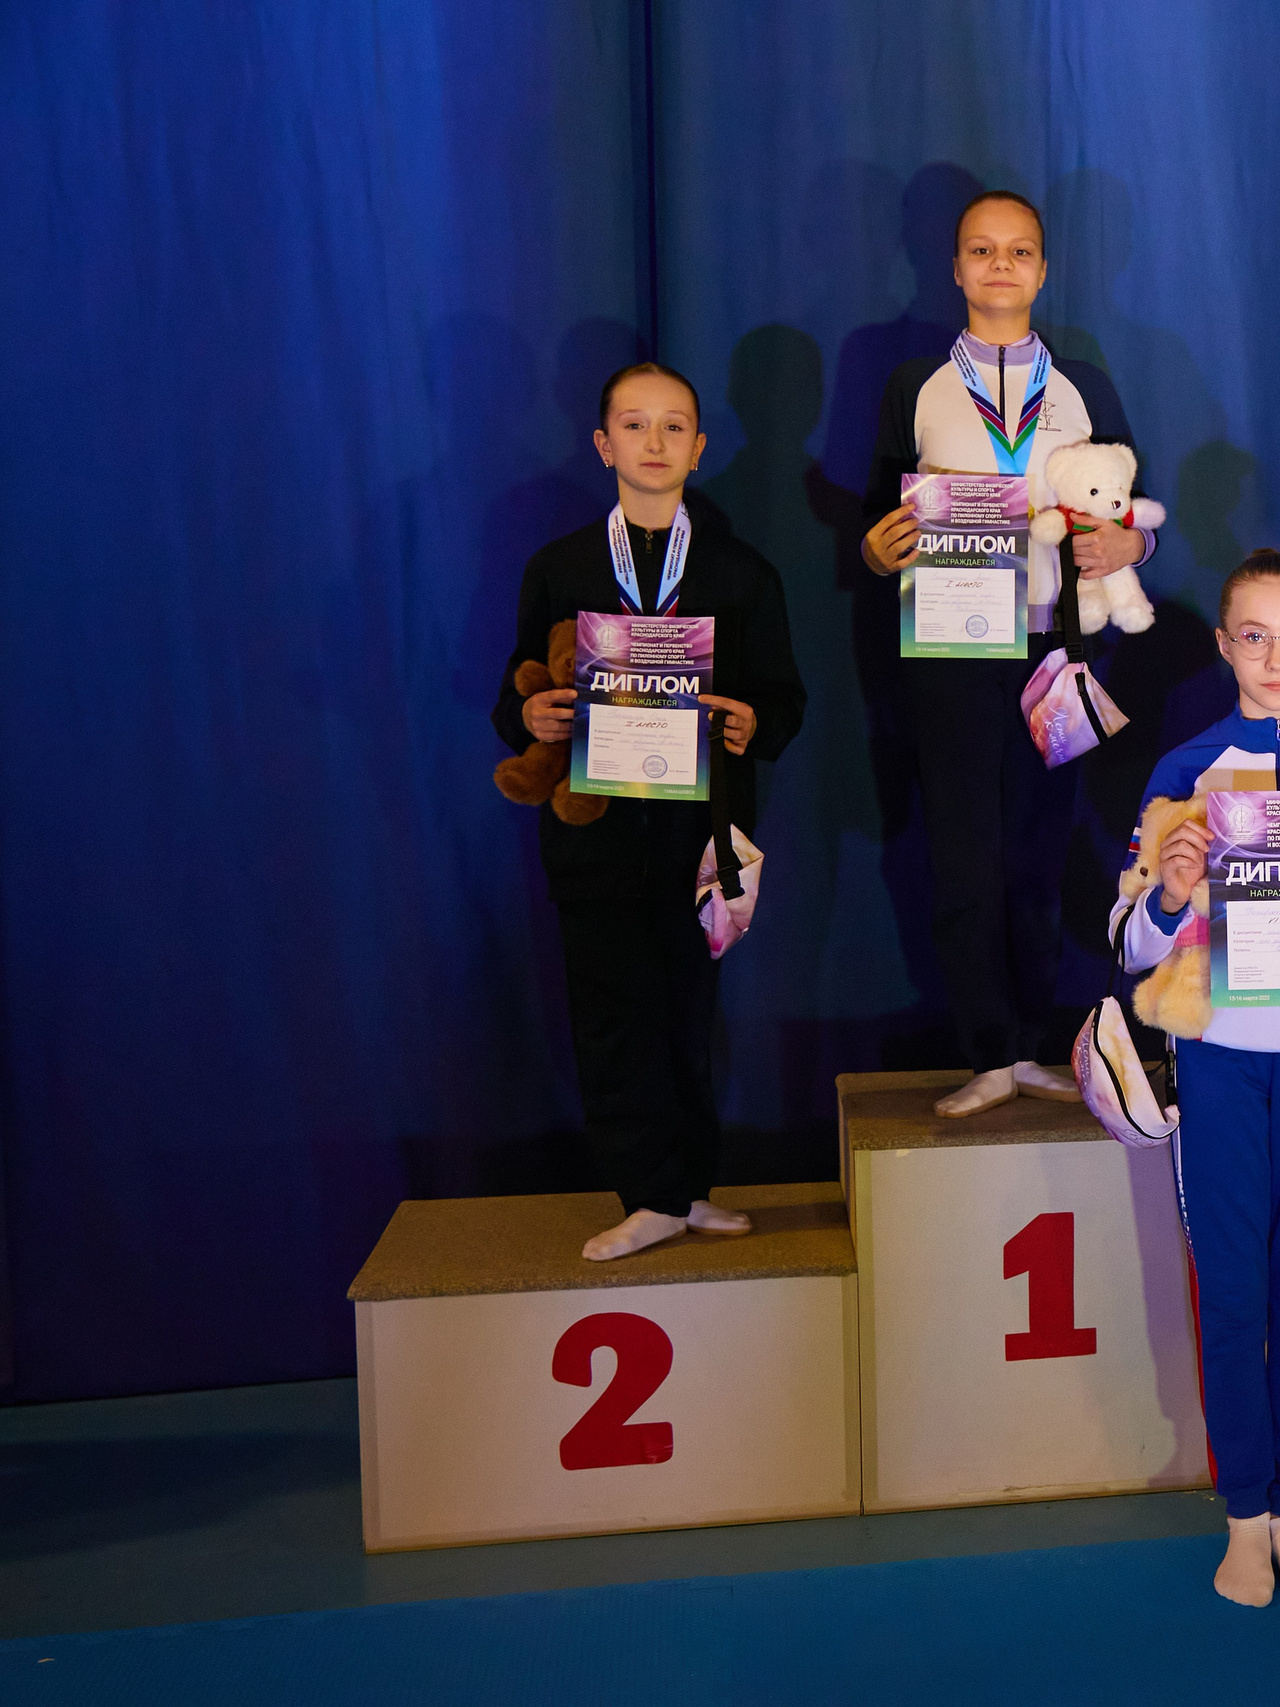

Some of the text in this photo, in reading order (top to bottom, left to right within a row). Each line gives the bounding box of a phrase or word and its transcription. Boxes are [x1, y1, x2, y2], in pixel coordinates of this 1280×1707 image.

[917, 534, 1016, 554] ДИПЛОМ
[936, 558, 996, 566] НАГРАЖДАЕТСЯ
[590, 672, 700, 694] ДИПЛОМ
[612, 696, 678, 706] НАГРАЖДАЕТСЯ
[1004, 1212, 1096, 1361] 1
[552, 1312, 673, 1470] 2
